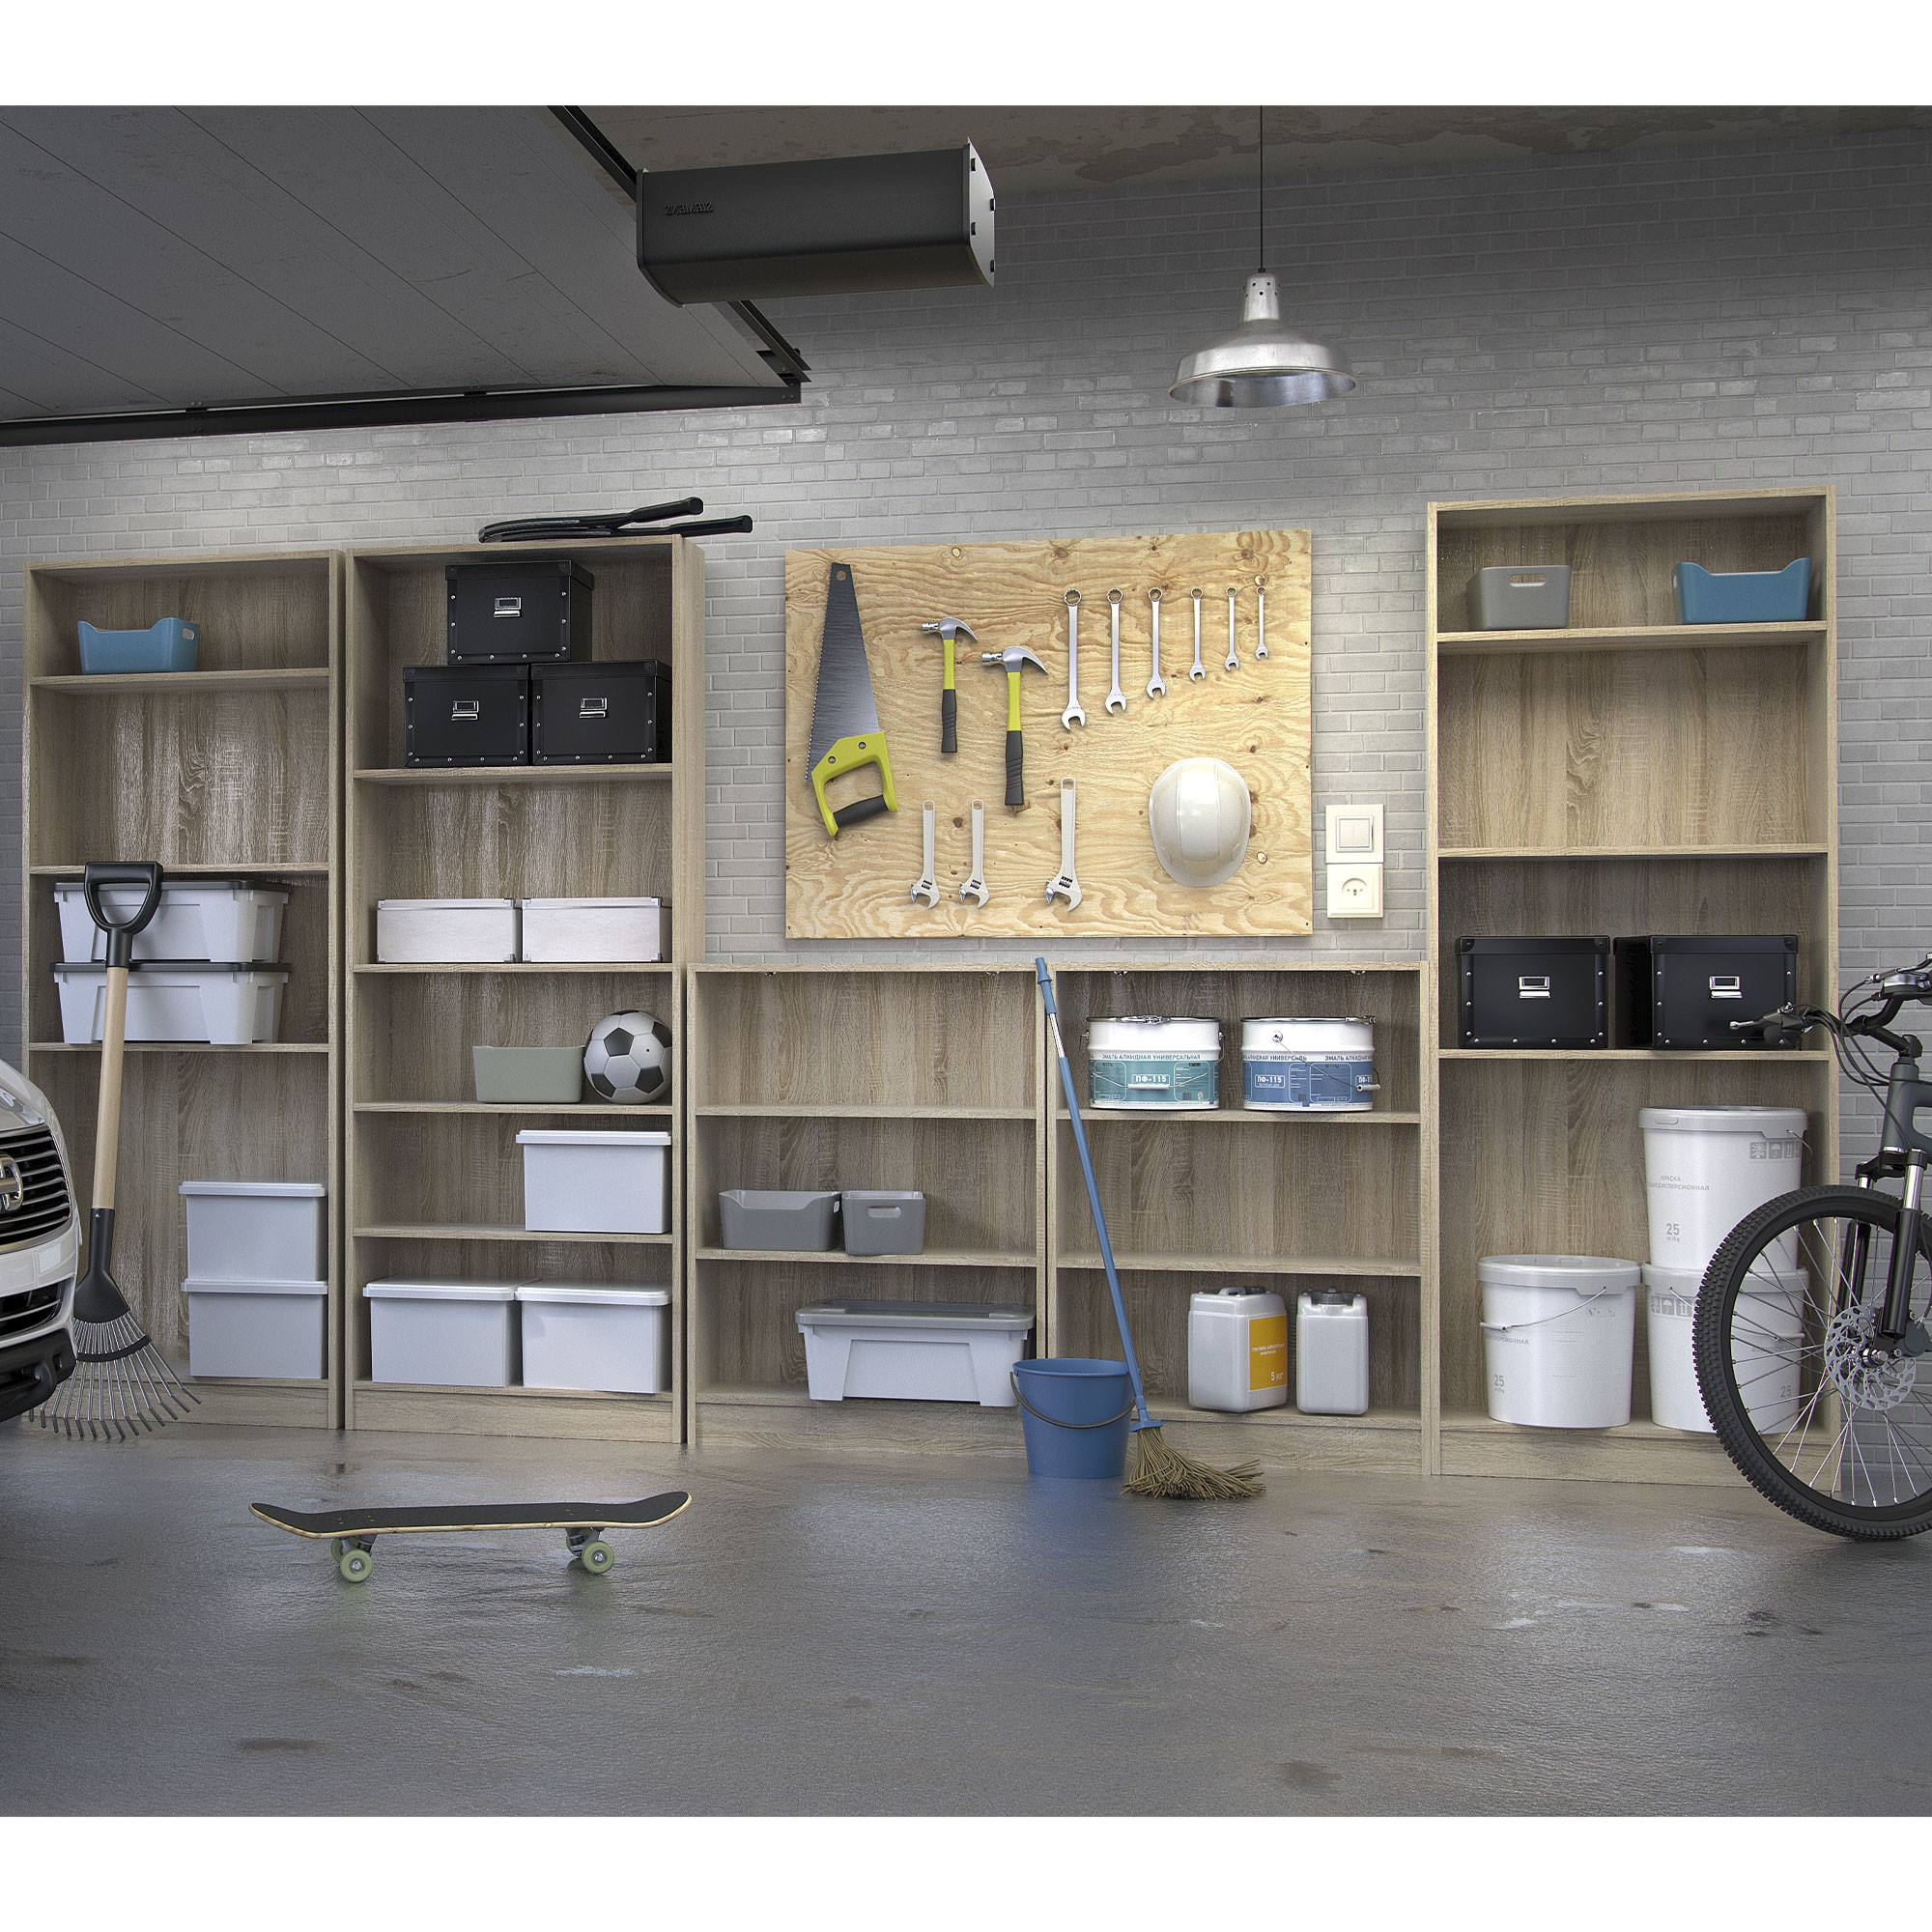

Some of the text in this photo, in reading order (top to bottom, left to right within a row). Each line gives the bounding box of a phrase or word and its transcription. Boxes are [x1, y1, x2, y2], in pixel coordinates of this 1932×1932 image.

[1257, 1075, 1282, 1084] ПФ-115
[1666, 1223, 1680, 1236] 25
[1270, 1372, 1275, 1380] 5
[1493, 1375, 1505, 1387] 25
[1780, 1384, 1792, 1398] 25
